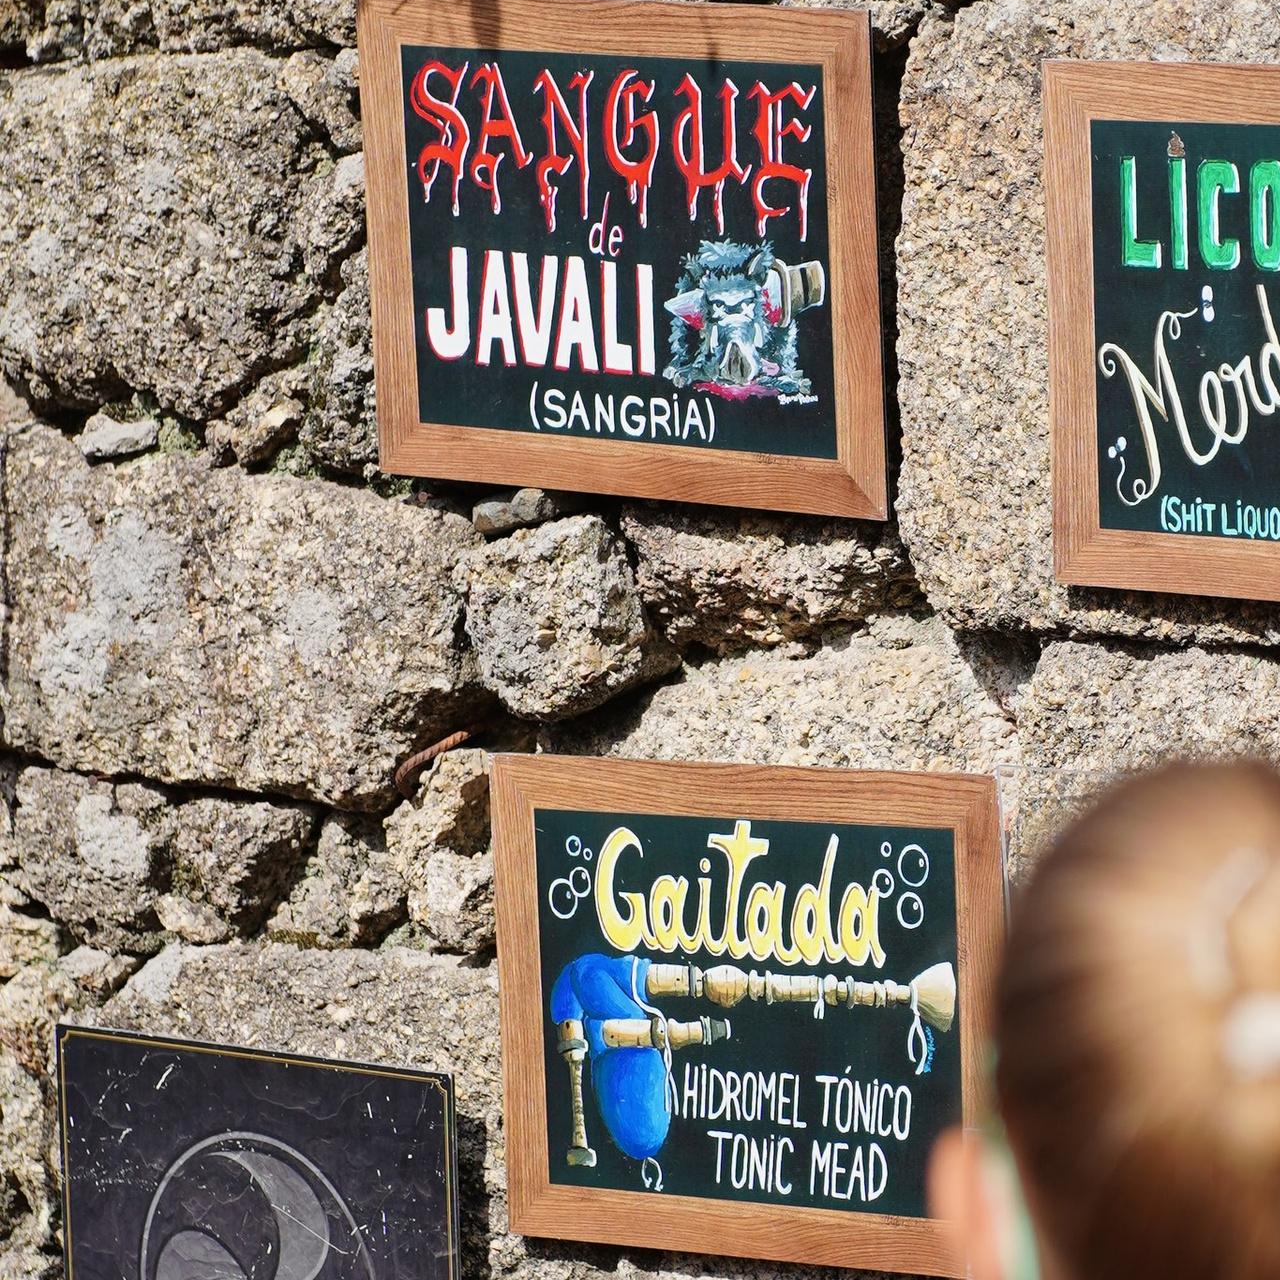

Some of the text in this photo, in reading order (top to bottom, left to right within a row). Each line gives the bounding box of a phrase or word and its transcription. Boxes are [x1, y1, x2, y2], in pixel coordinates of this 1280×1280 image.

[410, 60, 817, 243] SANGUE
[588, 192, 625, 258] de
[426, 246, 656, 376] JAVALI
[529, 380, 717, 443] (SANGRIA)
[1160, 495, 1215, 535] (SHIT
[595, 820, 887, 969] Gaitada
[681, 1062, 912, 1141] HIDROMEL TÓNICO
[706, 1129, 889, 1201] TONIC MEAD
